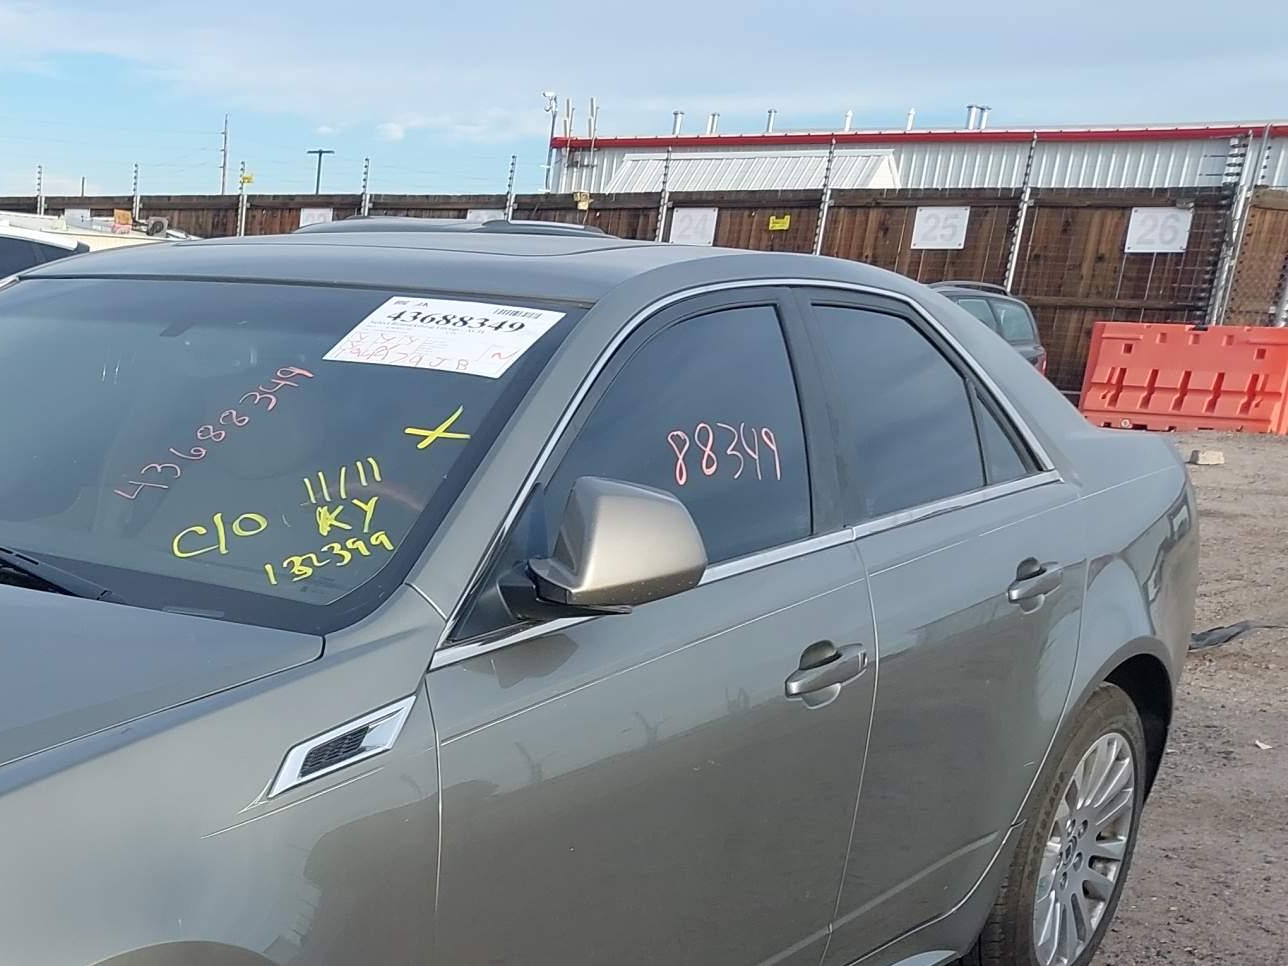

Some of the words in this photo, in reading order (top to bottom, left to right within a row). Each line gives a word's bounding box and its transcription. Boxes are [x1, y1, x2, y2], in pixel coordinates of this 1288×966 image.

[921, 213, 960, 242] 25
[1135, 213, 1180, 245] 26
[386, 309, 526, 333] 43688349
[113, 366, 314, 499] 43688349
[667, 422, 781, 486] 88349
[315, 496, 379, 536] KY
